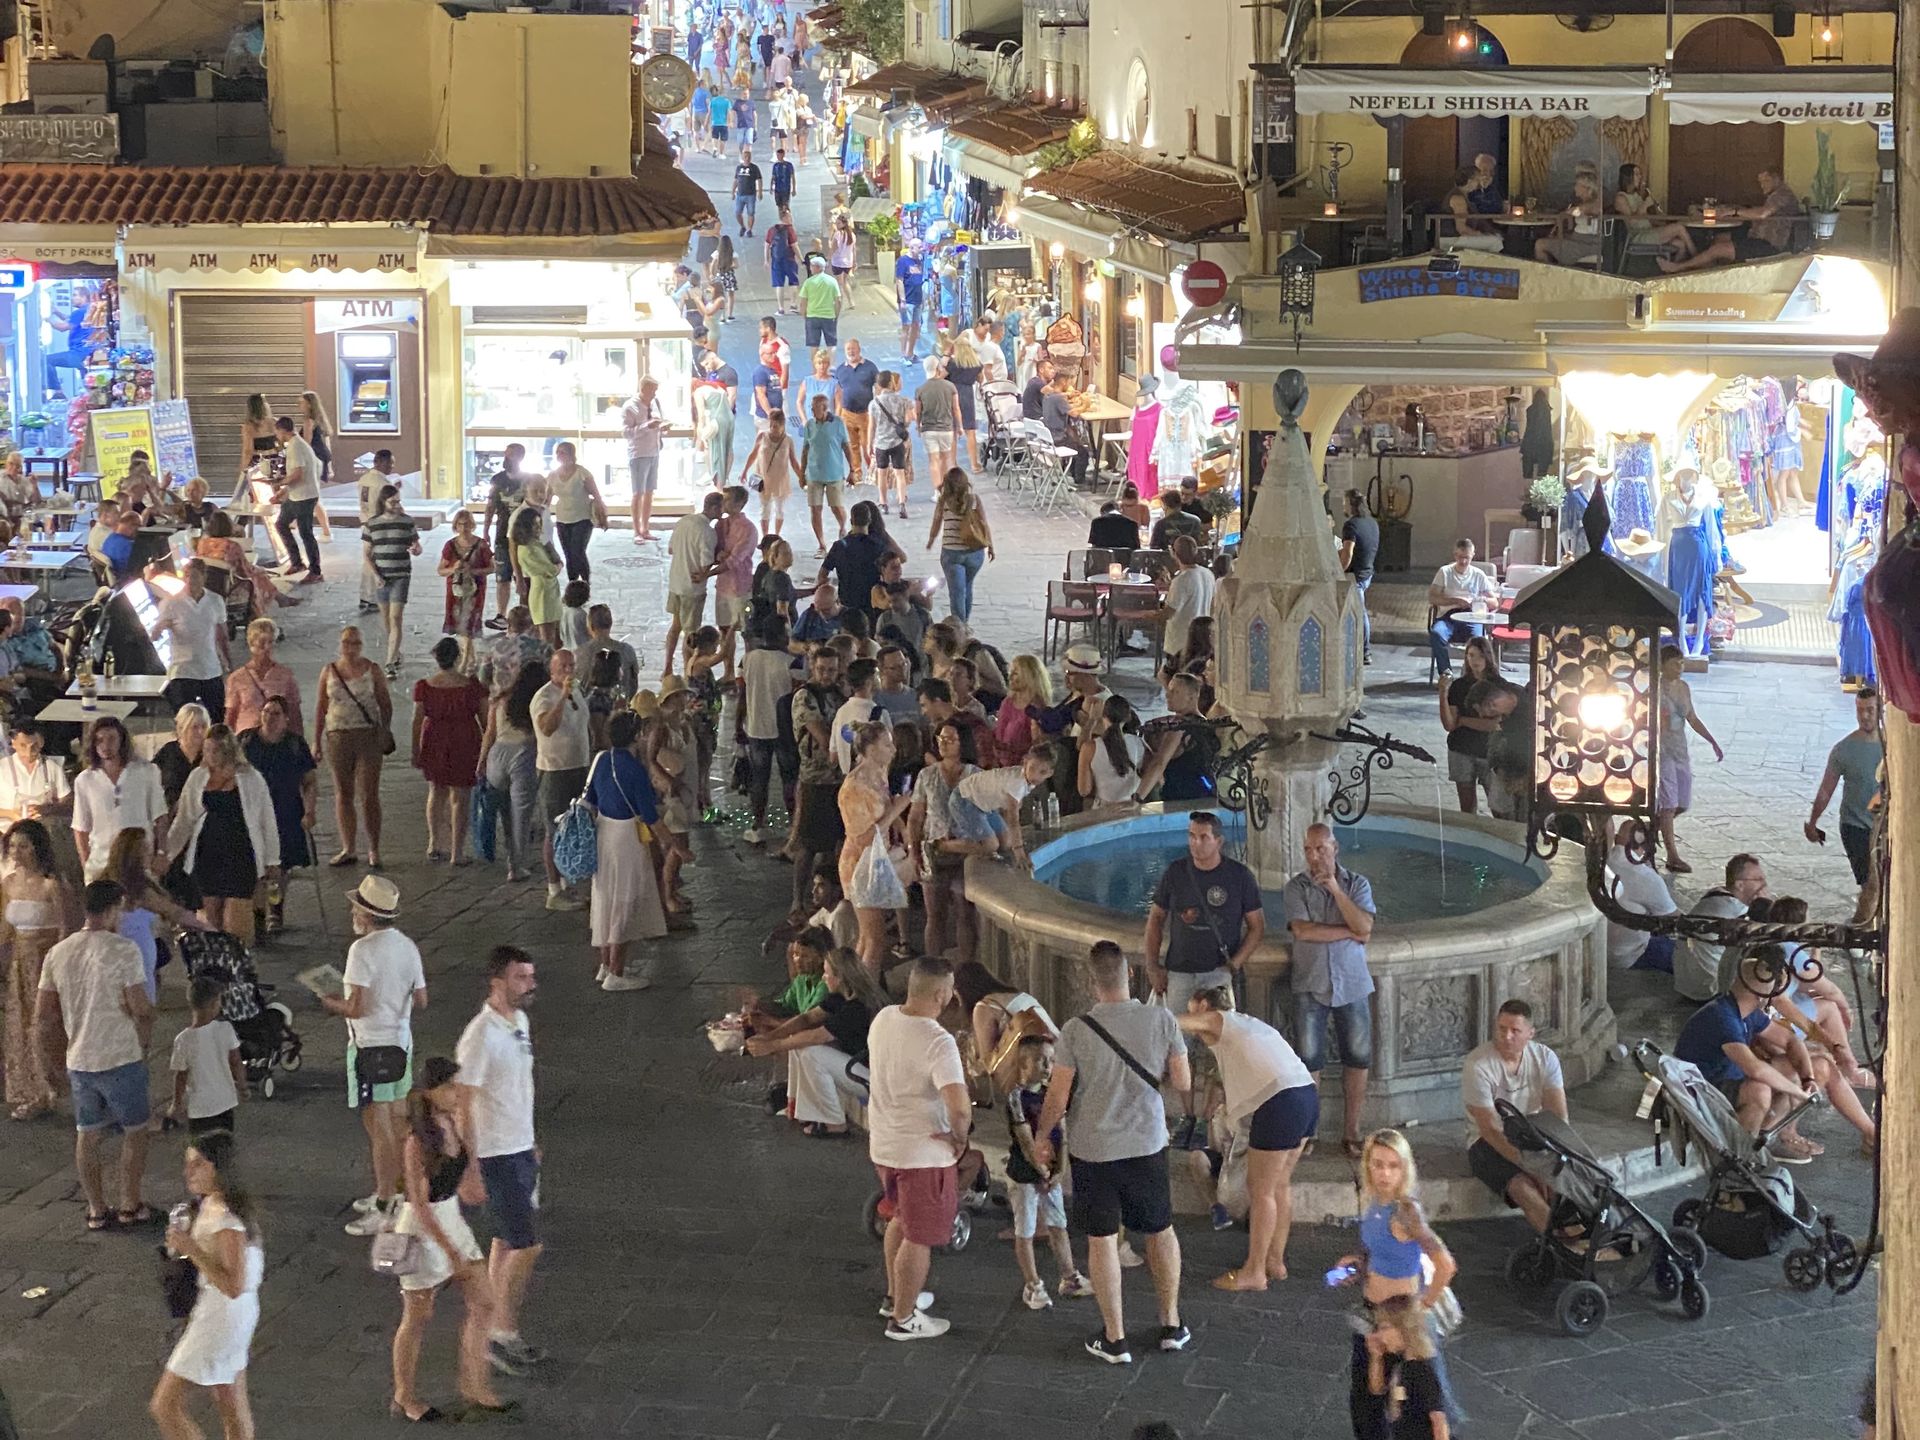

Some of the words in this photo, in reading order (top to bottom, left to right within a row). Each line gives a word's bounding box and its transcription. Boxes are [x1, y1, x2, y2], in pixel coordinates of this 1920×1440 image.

[1349, 96, 1436, 110] NEFELI
[1444, 96, 1533, 111] SHISHA
[1540, 97, 1589, 111] BAR
[1761, 102, 1865, 118] Cocktail
[128, 254, 156, 267] ATM
[189, 254, 217, 267] ATM
[249, 254, 278, 267] ATM
[310, 254, 338, 267] ATM
[377, 254, 405, 267] ATM
[342, 300, 393, 317] ATM
[1665, 307, 1704, 316] Summer
[1707, 307, 1746, 318] Loading
